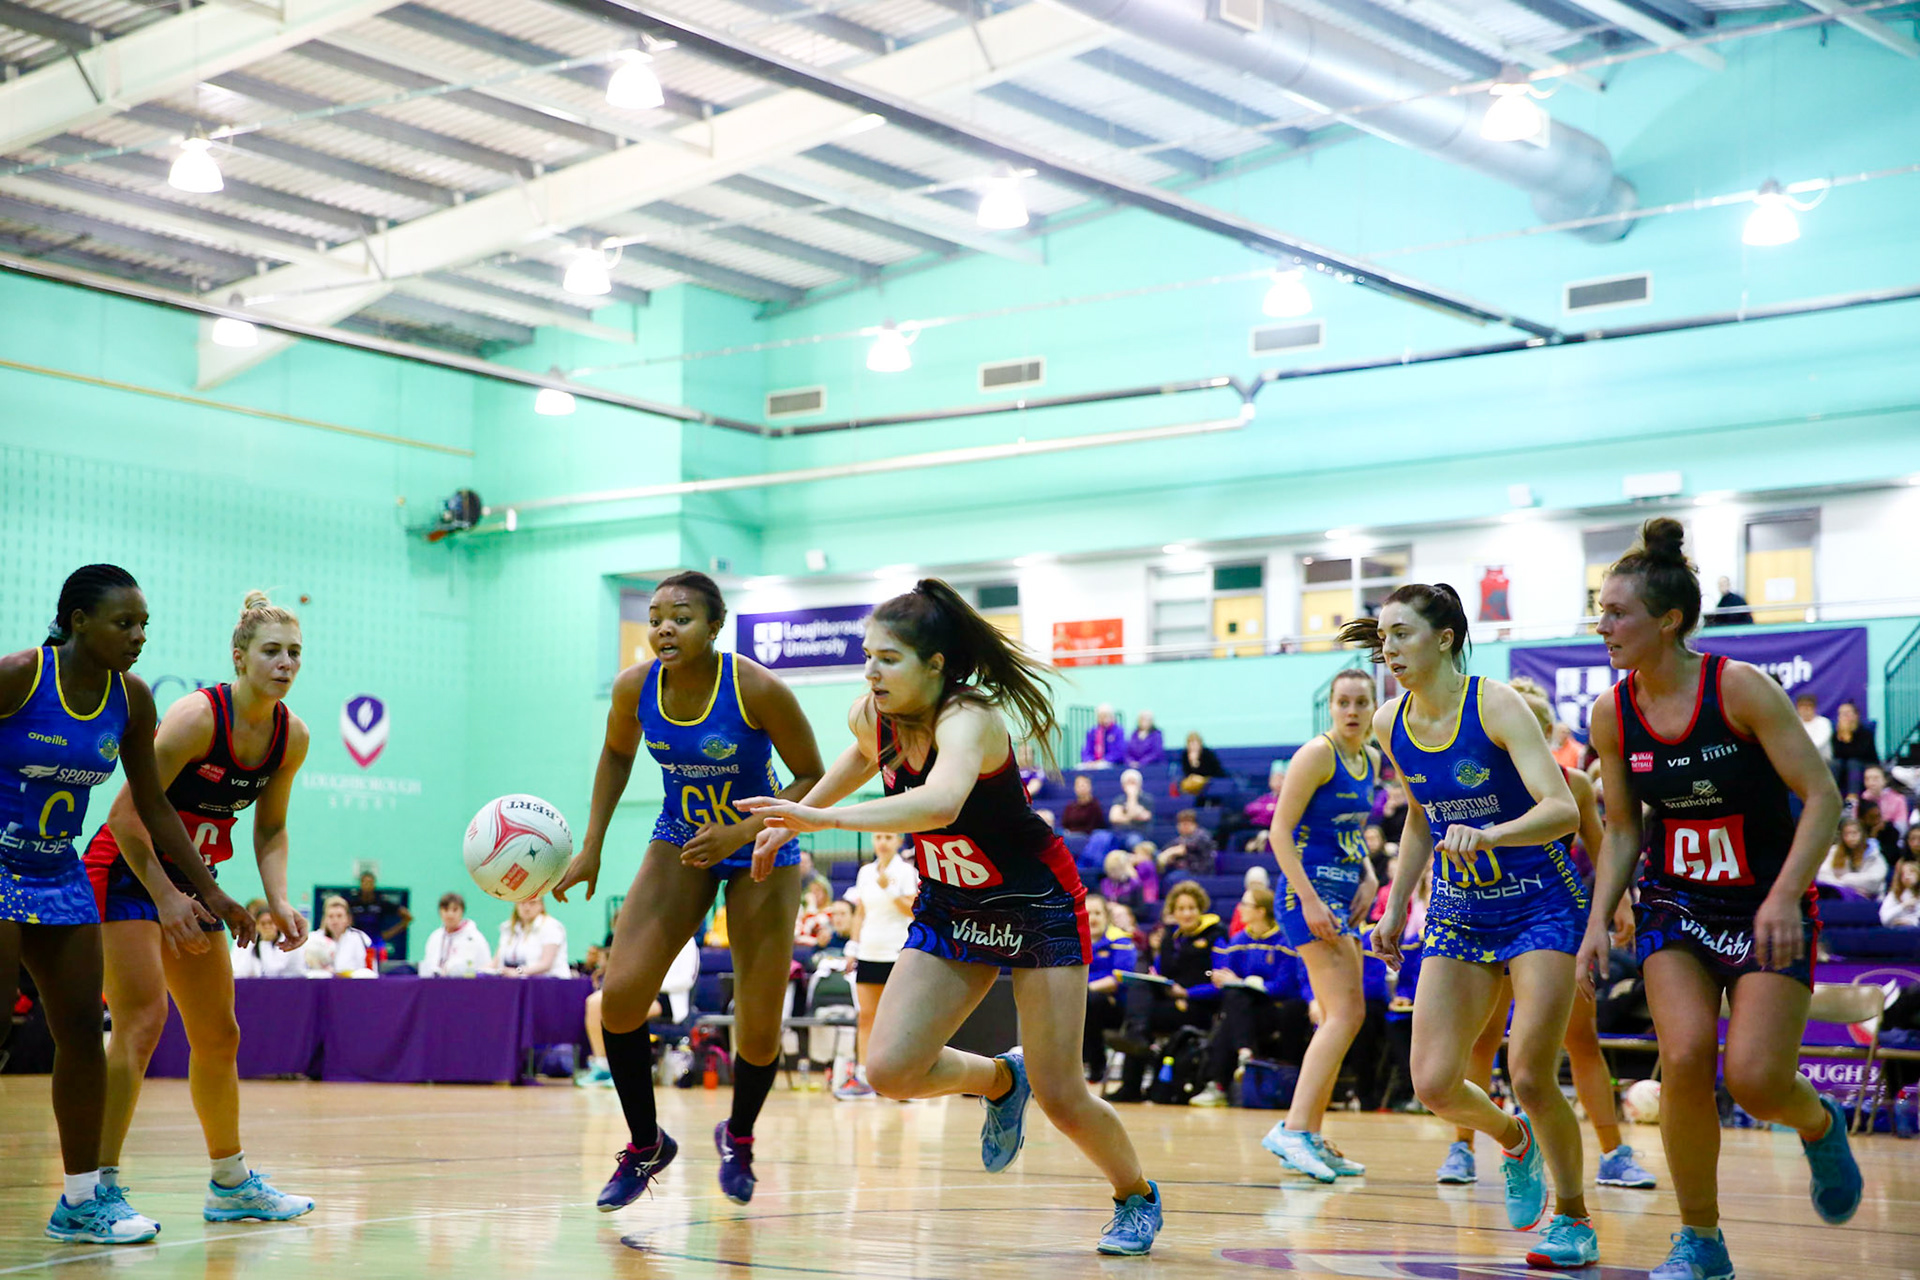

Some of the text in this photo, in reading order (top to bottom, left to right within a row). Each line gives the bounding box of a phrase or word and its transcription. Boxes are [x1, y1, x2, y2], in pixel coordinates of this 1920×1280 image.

[782, 617, 867, 641] Loughboroug
[782, 637, 848, 658] University
[28, 732, 68, 746] oneills
[1701, 743, 1738, 762] SIRENS
[681, 781, 742, 828] GK
[1435, 794, 1499, 813] SPORTING
[1442, 804, 1501, 822] FAMILY CHANGE
[1665, 796, 1723, 809] Strathclyde
[38, 790, 75, 840] C
[1673, 826, 1741, 881] GA
[951, 917, 1024, 956] Vitality
